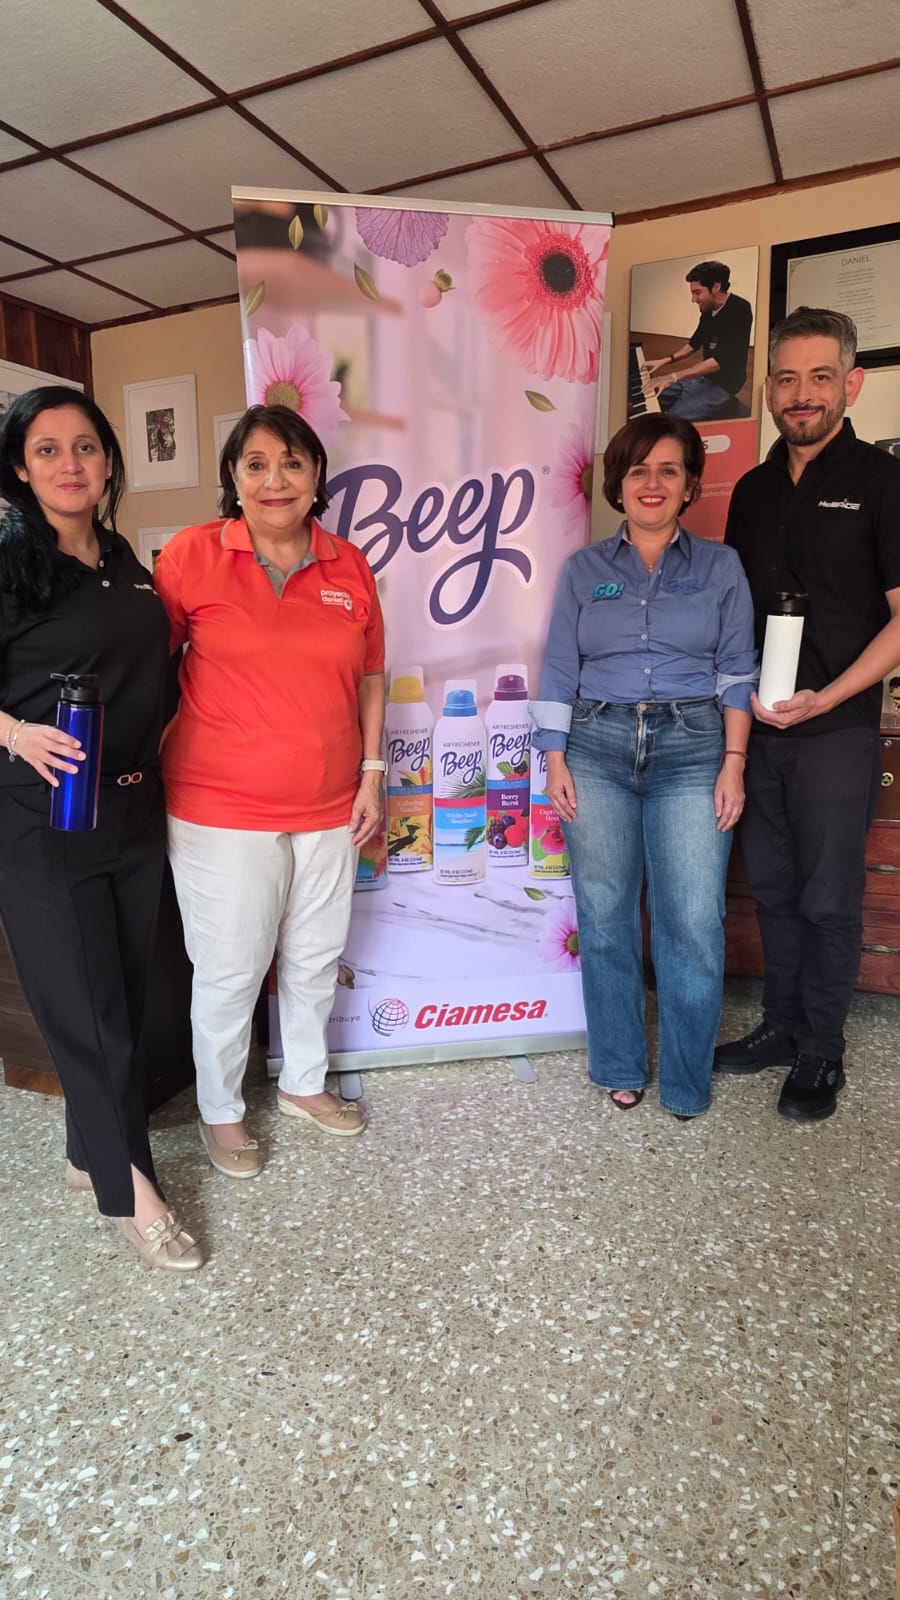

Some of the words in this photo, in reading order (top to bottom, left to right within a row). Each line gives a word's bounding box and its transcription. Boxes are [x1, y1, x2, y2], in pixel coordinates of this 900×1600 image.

[841, 255, 872, 266] DANIEL
[318, 464, 535, 625] Beep
[594, 583, 625, 598] GO!
[388, 737, 430, 771] Beep
[490, 732, 531, 766] Beep
[440, 750, 482, 784] Beep
[329, 1015, 361, 1024] tribuye
[415, 1000, 547, 1029] Ciamesa
